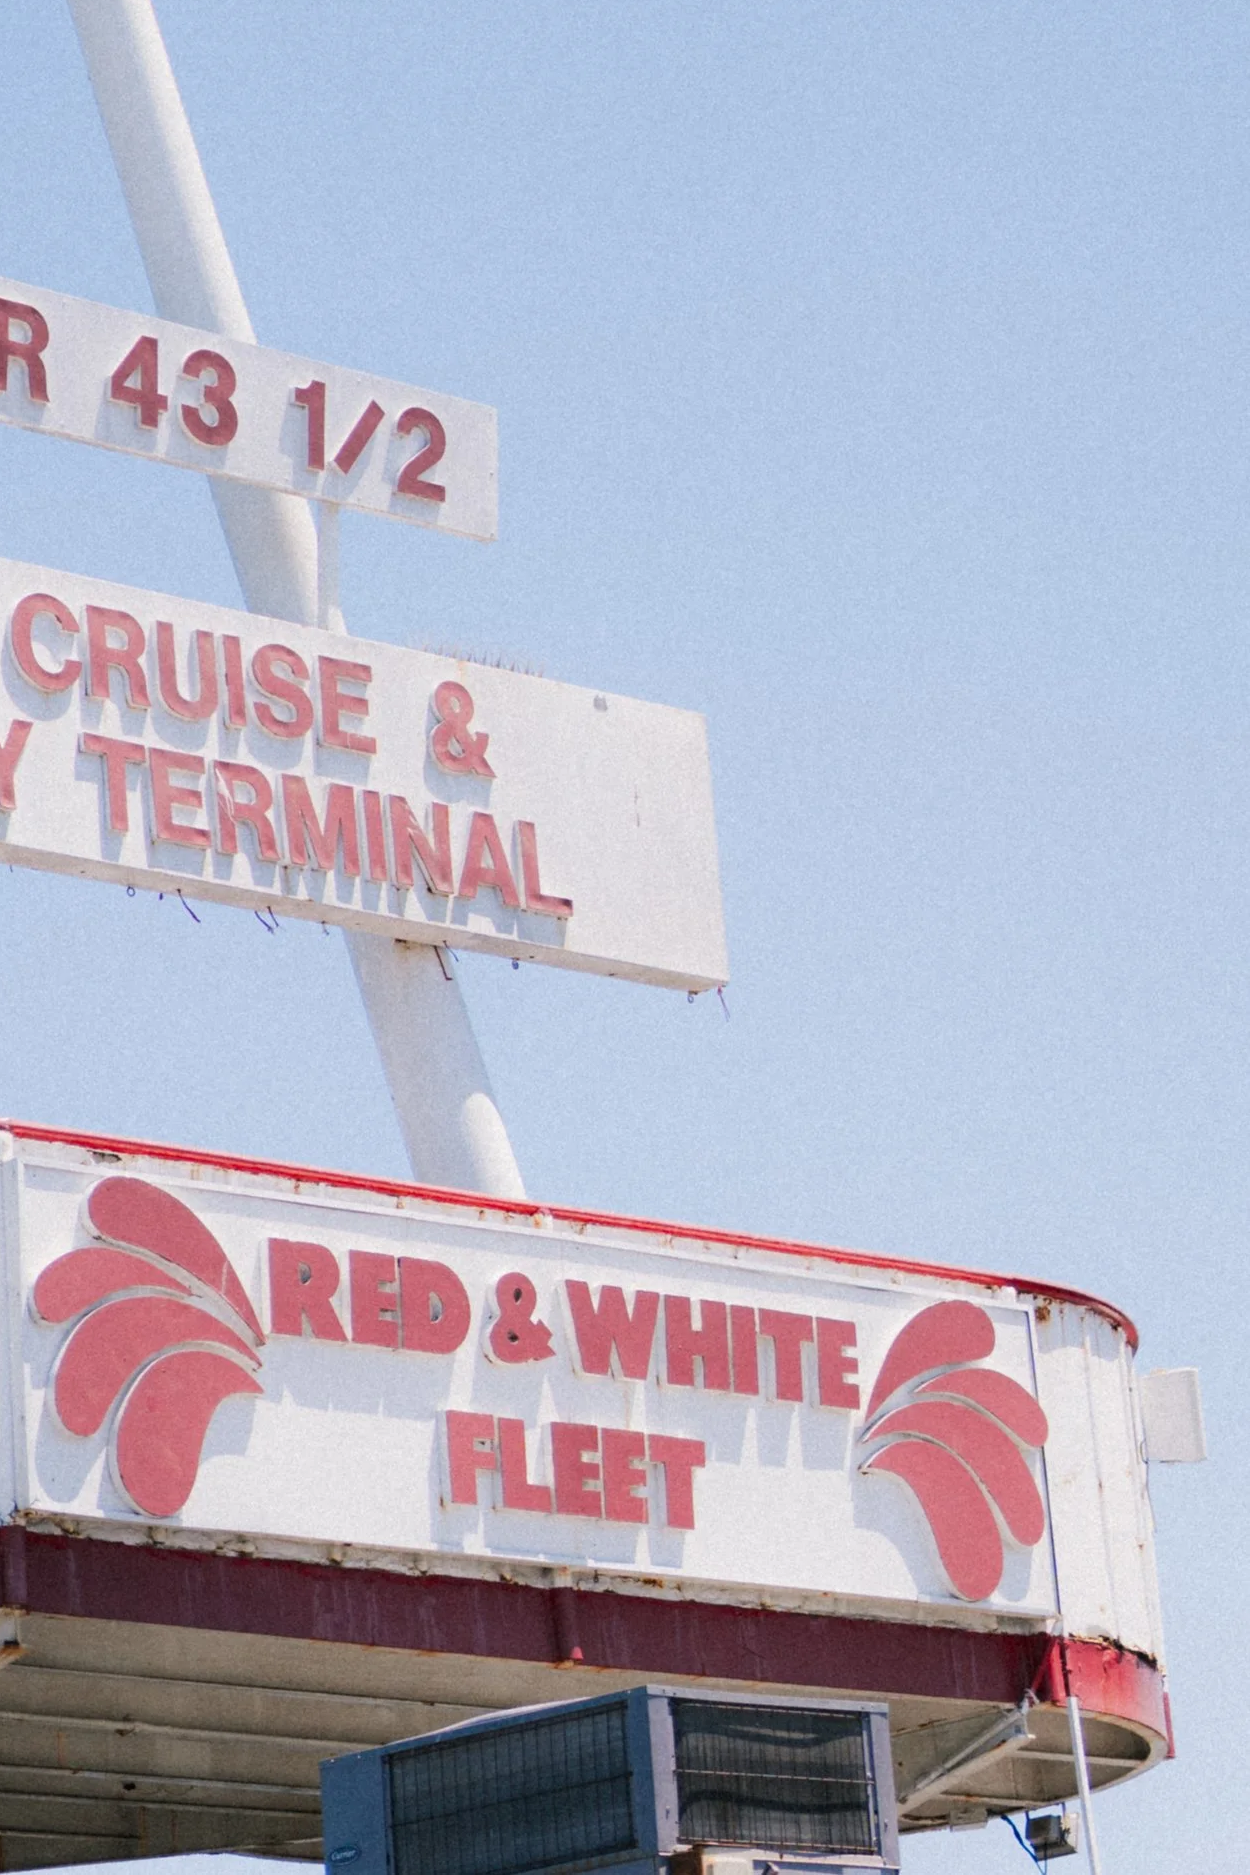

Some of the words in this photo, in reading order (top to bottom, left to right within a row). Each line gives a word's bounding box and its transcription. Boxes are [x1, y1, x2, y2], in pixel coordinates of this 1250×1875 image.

[109, 336, 238, 446] 43
[293, 380, 447, 503] 1/2
[10, 593, 378, 755] CRUISE
[430, 679, 496, 779] &
[79, 733, 574, 921] TERMINAL
[267, 1237, 472, 1355] RED
[487, 1272, 557, 1364] &
[563, 1279, 861, 1411] WHITE
[444, 1409, 706, 1530] FLEET
